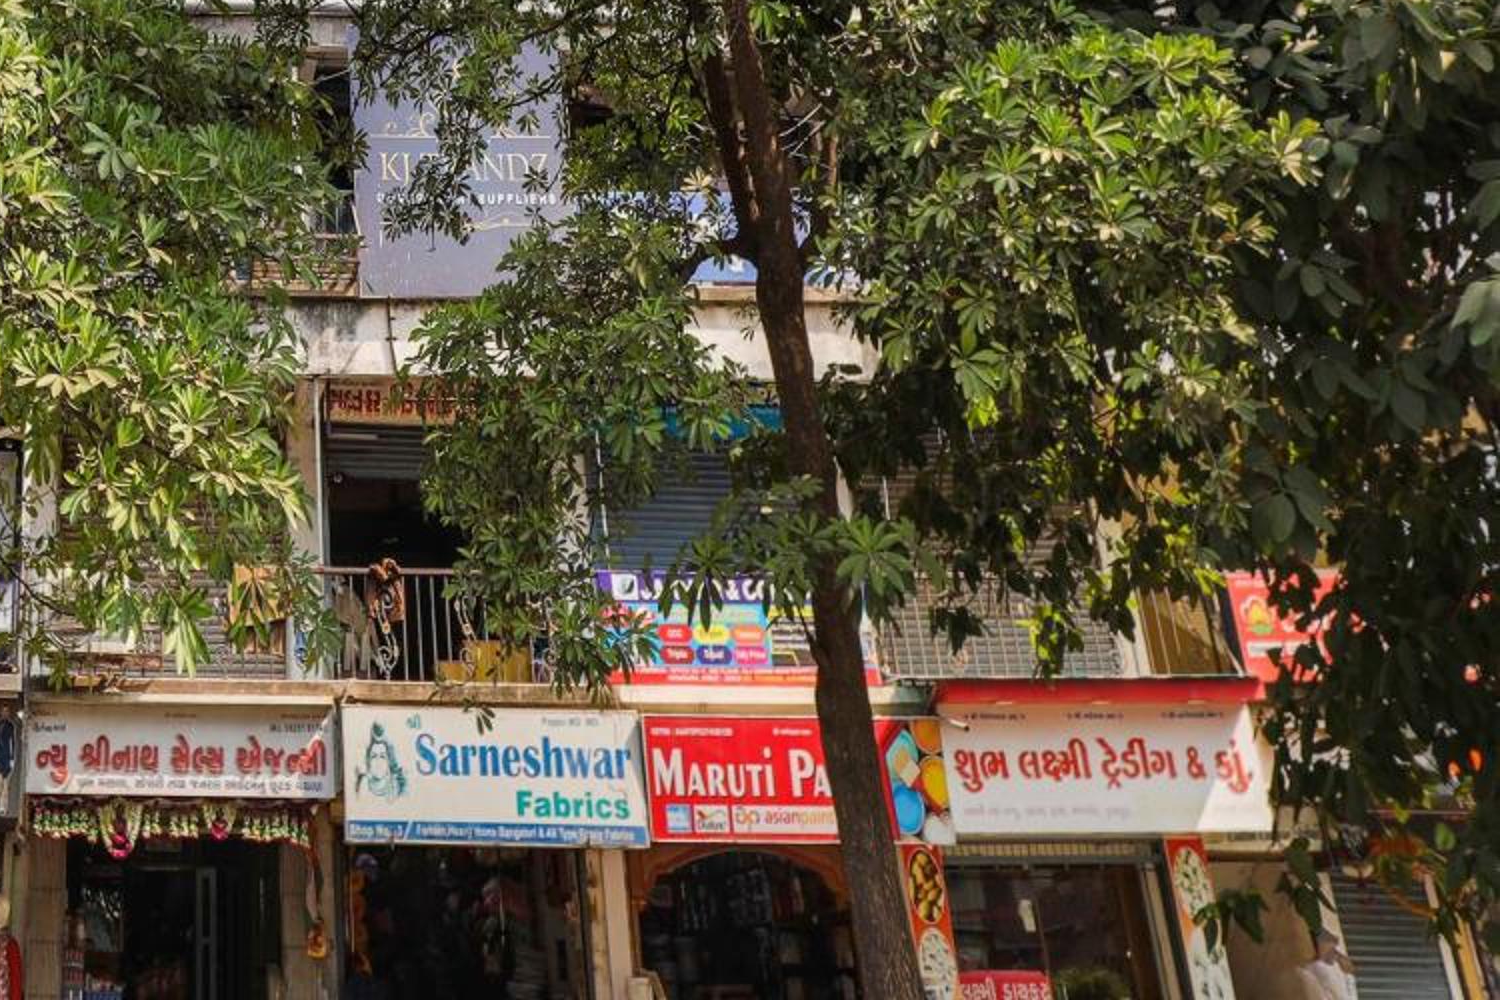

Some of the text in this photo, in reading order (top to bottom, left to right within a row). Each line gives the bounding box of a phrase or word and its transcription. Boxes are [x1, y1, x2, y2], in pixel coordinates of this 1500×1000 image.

[415, 733, 631, 779] Sarneshwar
[954, 749, 1010, 794] શુભ
[1019, 737, 1092, 783] લક્ષ્મી
[1187, 745, 1206, 780] &
[516, 790, 631, 820] Fabrics
